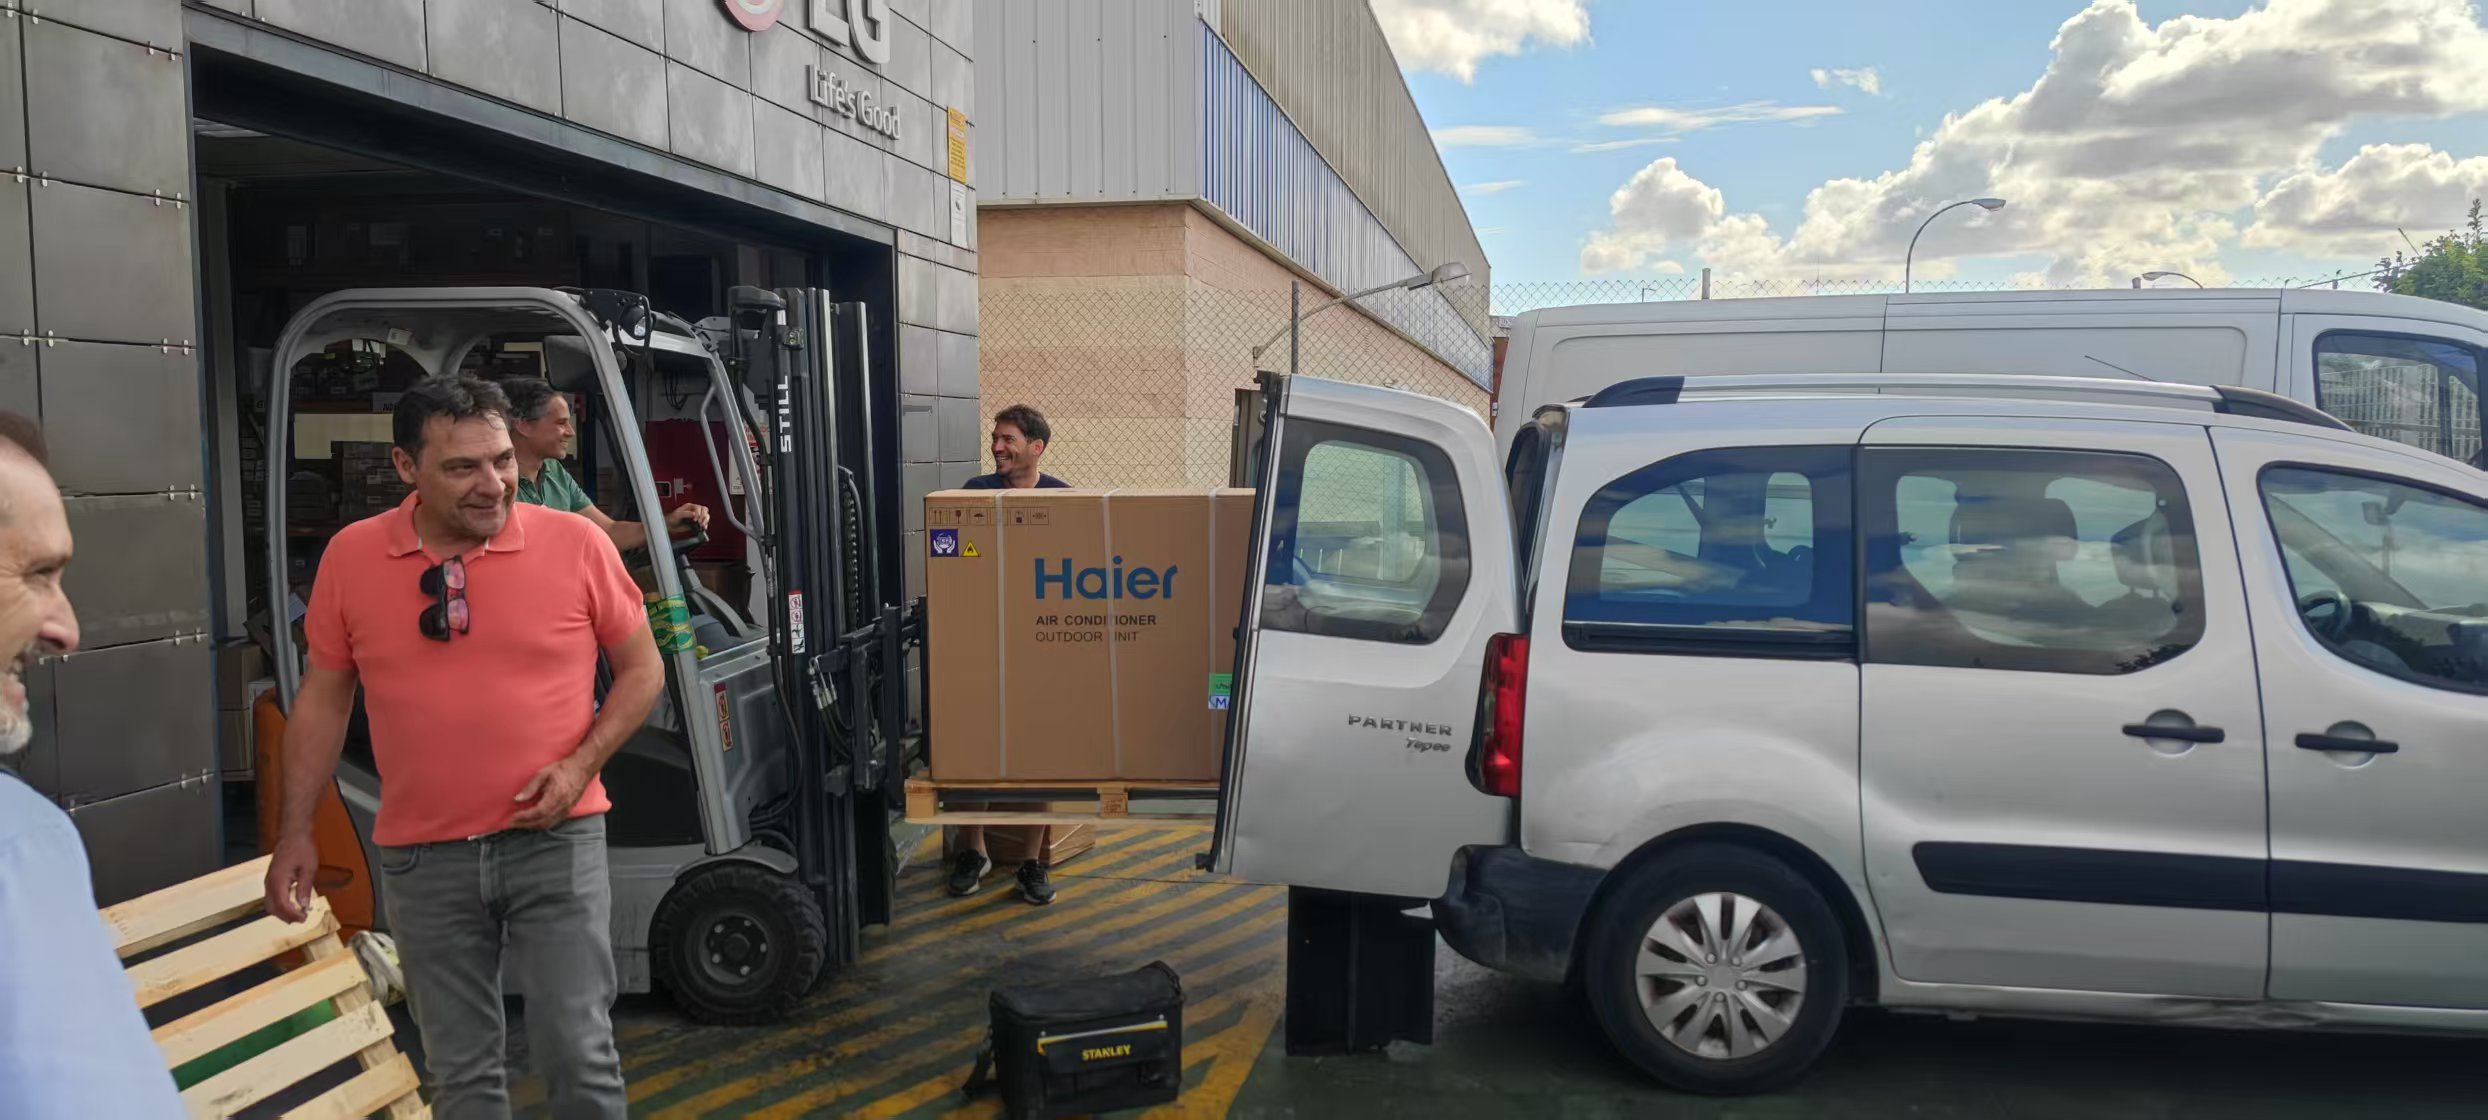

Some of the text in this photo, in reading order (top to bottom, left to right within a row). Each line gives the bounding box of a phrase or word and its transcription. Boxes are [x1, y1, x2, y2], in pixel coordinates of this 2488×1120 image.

[809, 64, 900, 139] Life's Good
[777, 375, 791, 453] STILL
[1034, 555, 1178, 600] Haier
[1036, 614, 1157, 626] AIR CONDIIONER
[1035, 631, 1103, 642] OUTDOOR
[1348, 714, 1452, 736] PARTNER
[1406, 737, 1451, 753] Tepee
[1082, 1045, 1131, 1061] STANLEY
